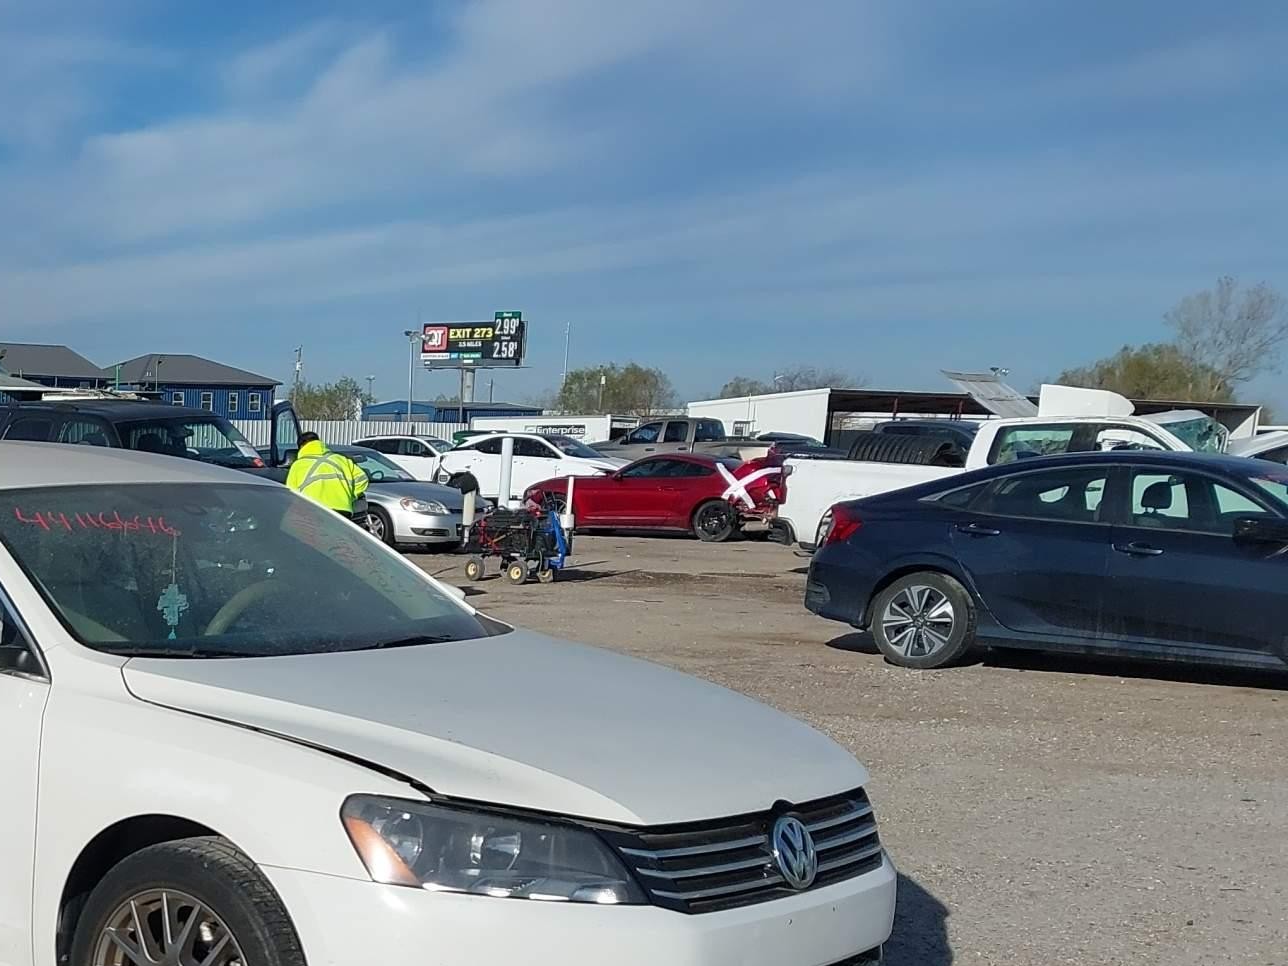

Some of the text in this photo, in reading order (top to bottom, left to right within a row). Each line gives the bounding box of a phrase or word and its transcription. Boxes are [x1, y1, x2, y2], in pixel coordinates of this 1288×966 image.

[449, 328, 472, 339] EXIT
[474, 327, 493, 338] 273
[537, 426, 585, 435] Enterprise
